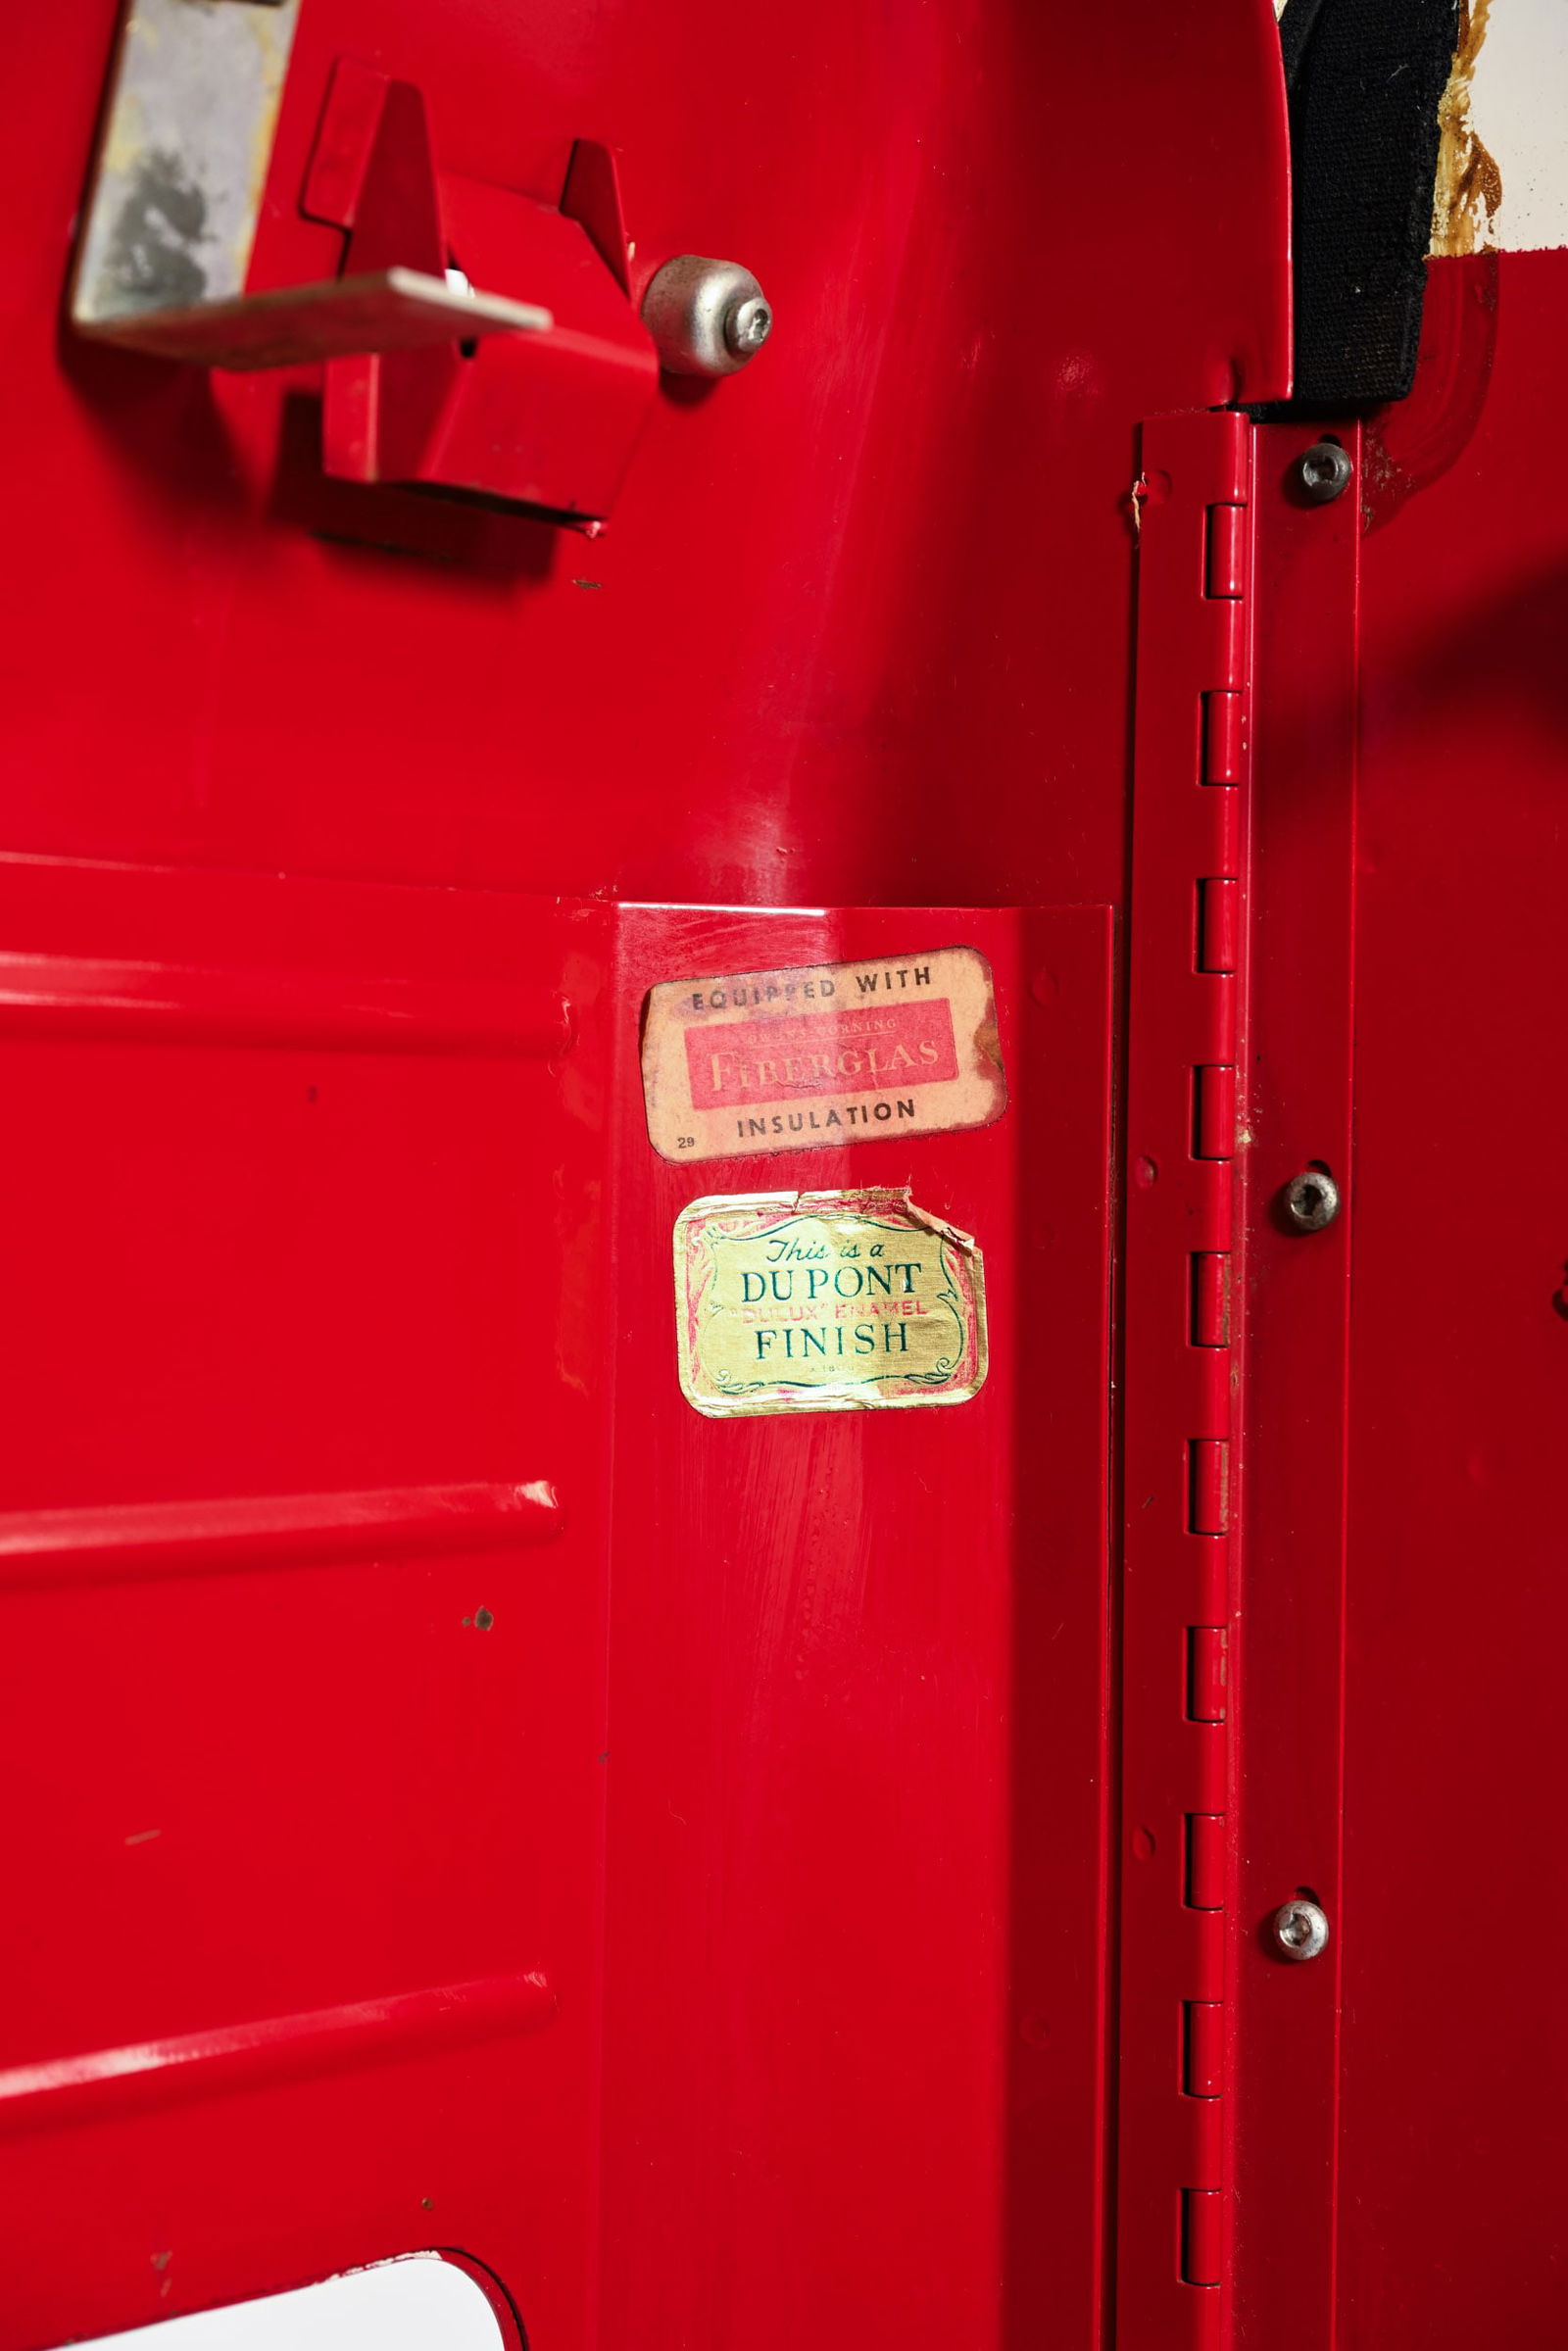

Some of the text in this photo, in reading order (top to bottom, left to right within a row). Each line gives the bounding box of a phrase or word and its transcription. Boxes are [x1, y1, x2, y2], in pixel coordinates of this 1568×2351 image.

[692, 966, 931, 1011] EQUIPPED WITH
[737, 1099, 916, 1138] INSULATION
[677, 1136, 695, 1149] 29
[766, 1239, 884, 1262] This is a
[834, 1299, 930, 1320] ENAMEL
[755, 1322, 909, 1360] FINISH
